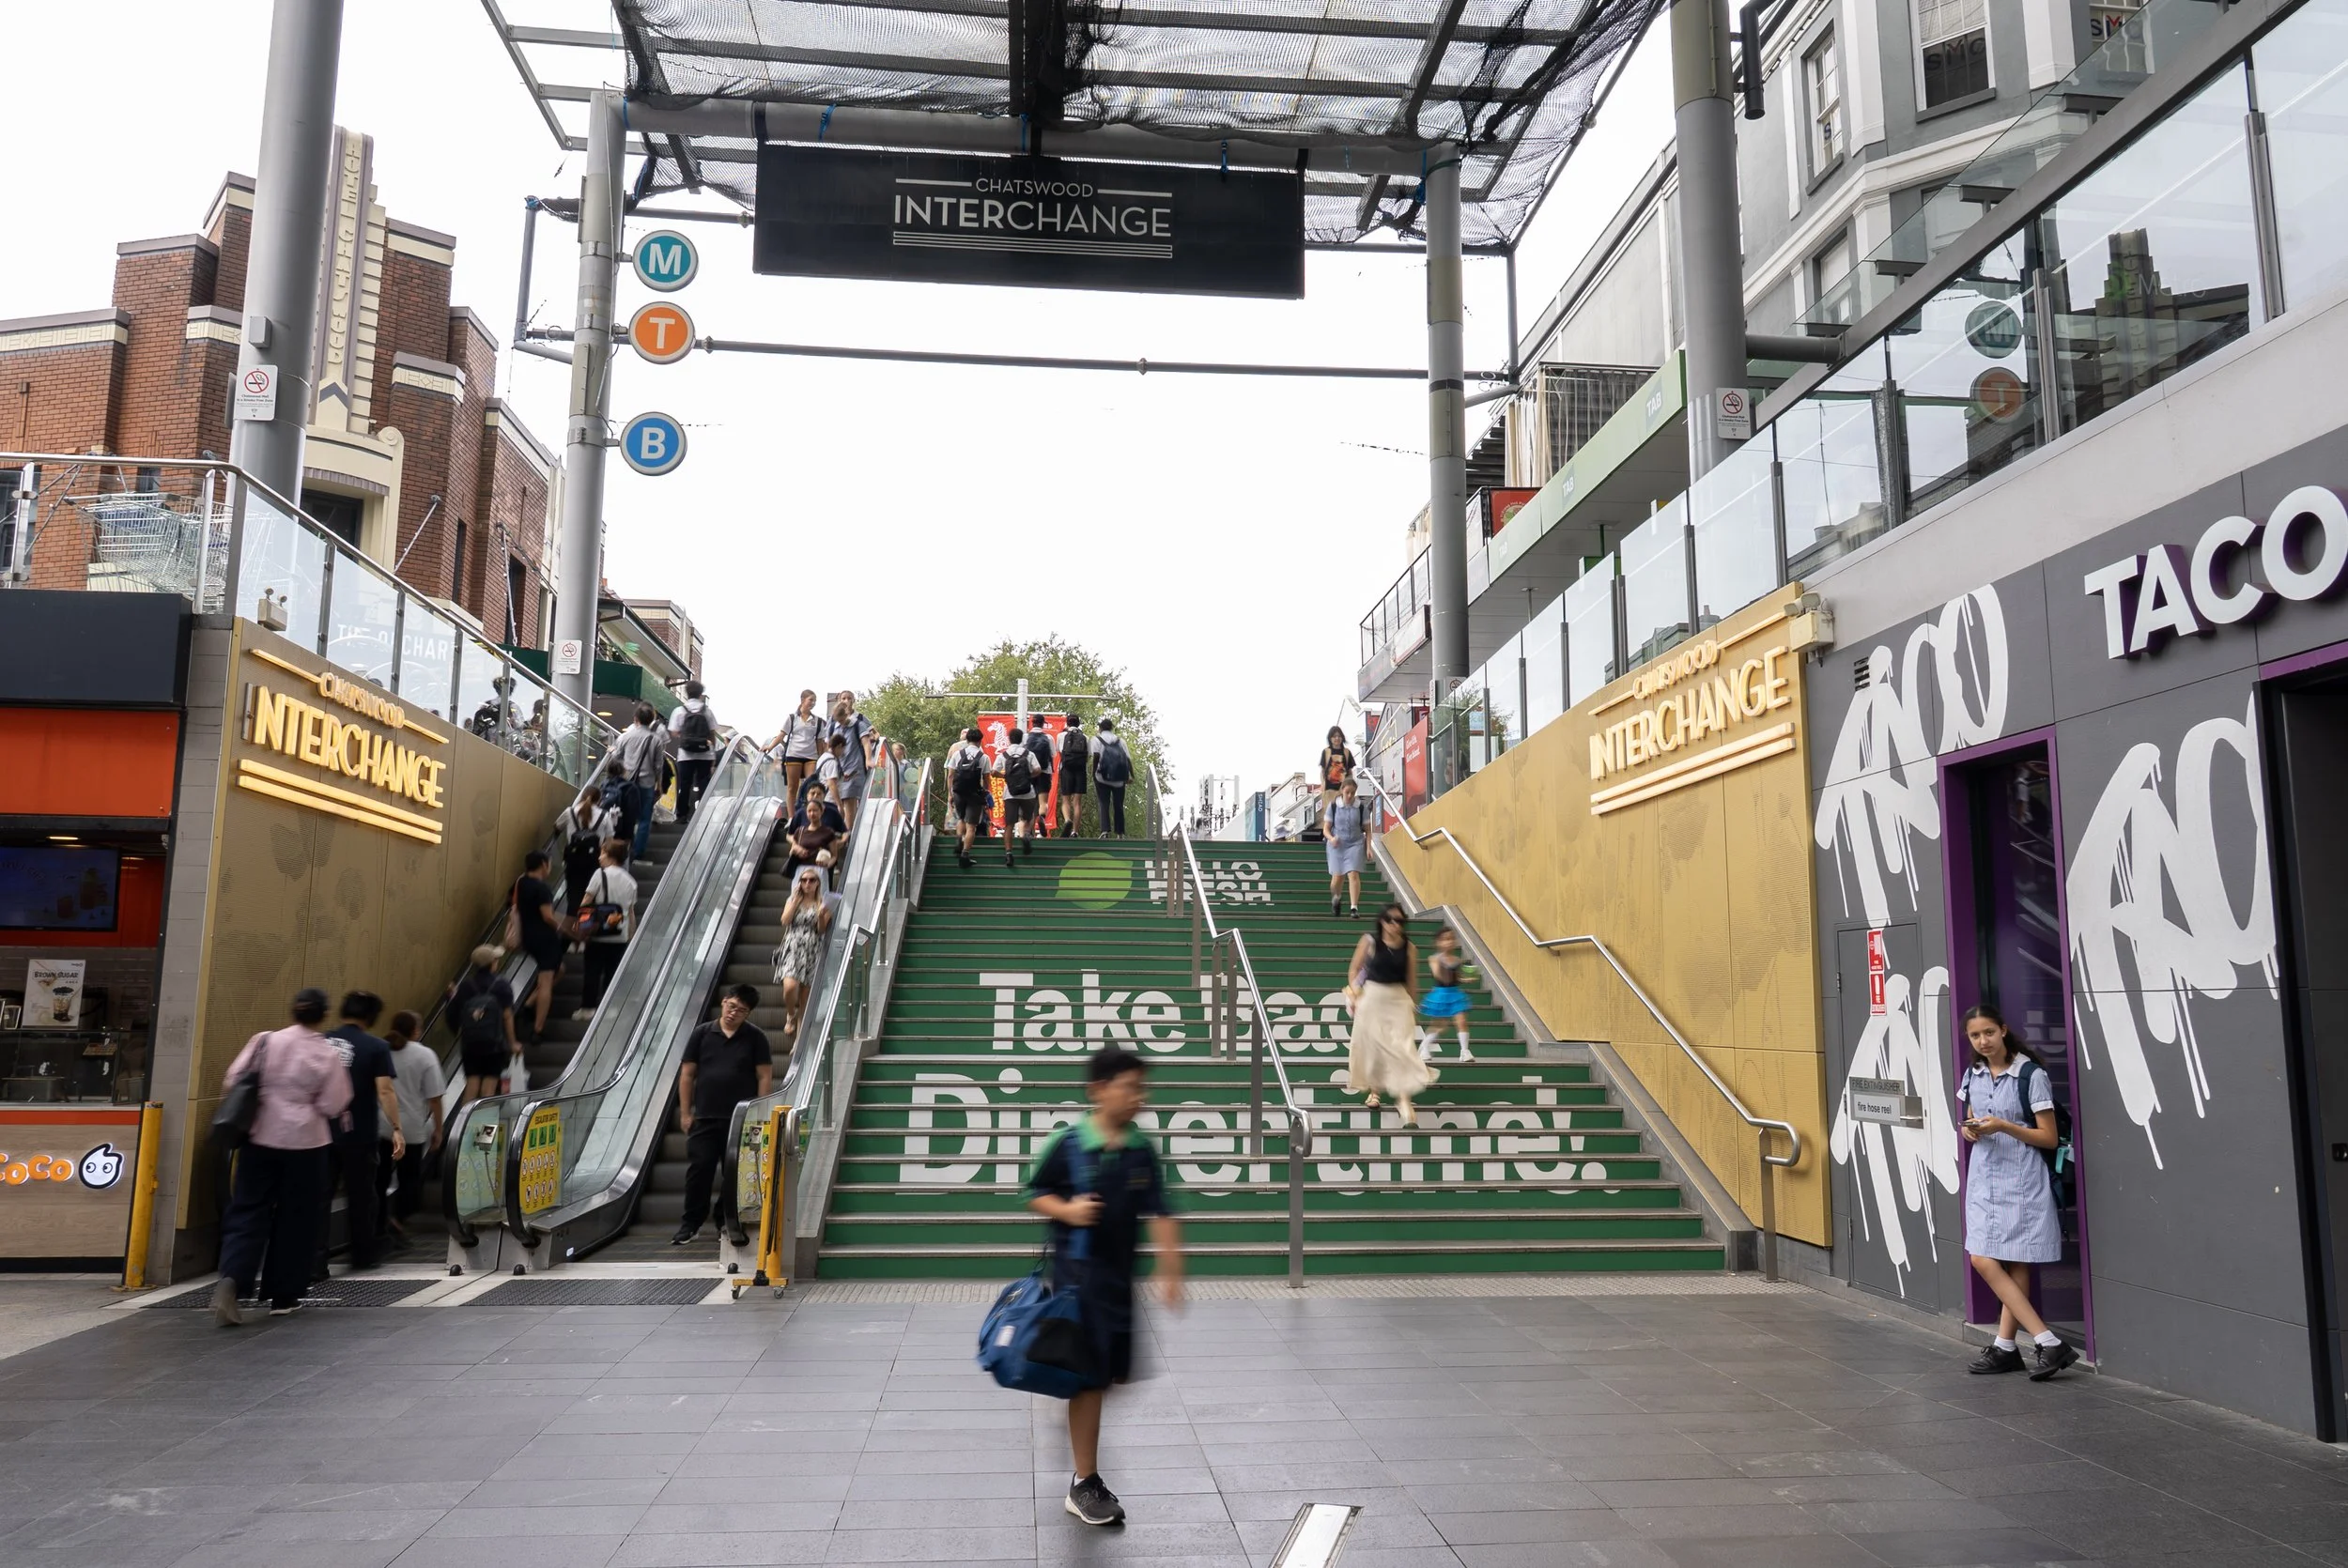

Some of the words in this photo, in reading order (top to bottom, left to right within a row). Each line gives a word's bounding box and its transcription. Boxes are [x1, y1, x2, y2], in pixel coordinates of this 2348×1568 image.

[975, 177, 1094, 198] CHATSWOOD
[894, 194, 1172, 238] INTERCHANGE
[648, 242, 683, 276] M
[649, 316, 676, 349] T
[1645, 393, 1662, 418] TAB
[641, 426, 667, 460] B
[1562, 474, 1575, 498] TAB
[2084, 484, 2348, 660] TACO
[1632, 639, 1721, 699] CHATSWOOD
[317, 671, 406, 730] CHATSWOOD
[1588, 645, 1792, 780] INTERCHANGE
[1145, 861, 1263, 881] HELLO
[1149, 881, 1274, 906] FRESH
[2066, 691, 2278, 1170] TAC
[979, 968, 1187, 1053] Take
[1858, 1101, 1866, 1112] fire
[1867, 1102, 1880, 1114] hose
[1881, 1104, 1892, 1115] reel
